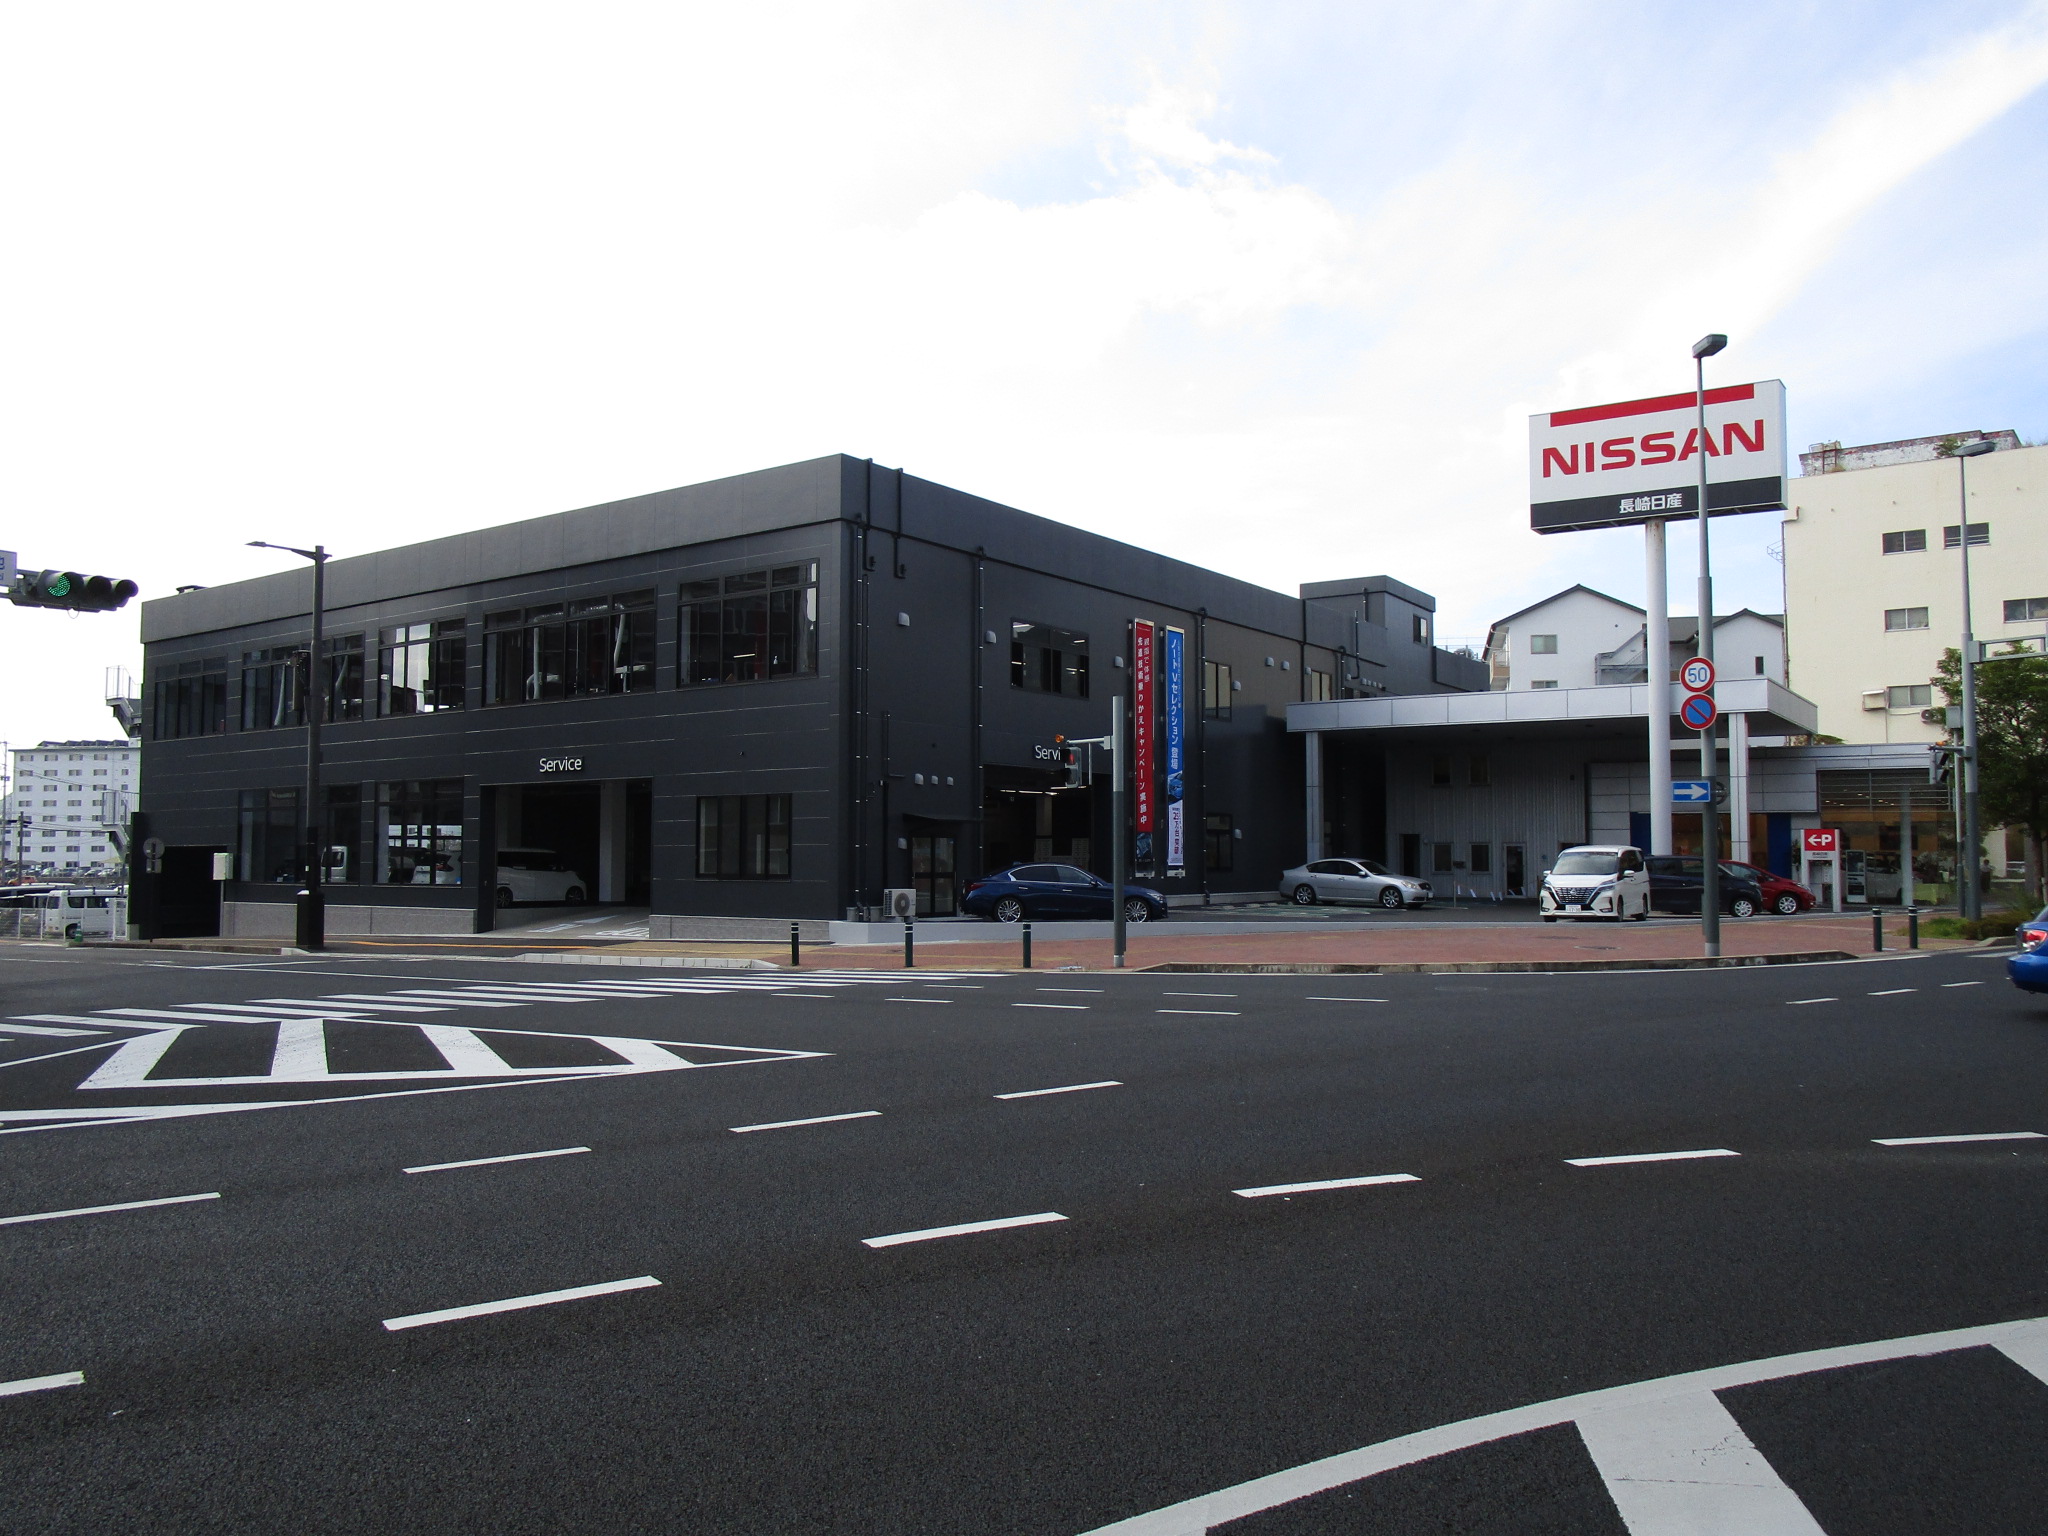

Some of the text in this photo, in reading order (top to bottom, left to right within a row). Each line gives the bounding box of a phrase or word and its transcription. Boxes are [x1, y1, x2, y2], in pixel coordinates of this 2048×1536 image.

[1543, 419, 1764, 478] NISSAN
[1619, 493, 1682, 514] 長崎日産
[1688, 667, 1708, 684] 50
[1034, 745, 1061, 761] Servi
[539, 756, 582, 773] Service
[1821, 834, 1832, 846] P
